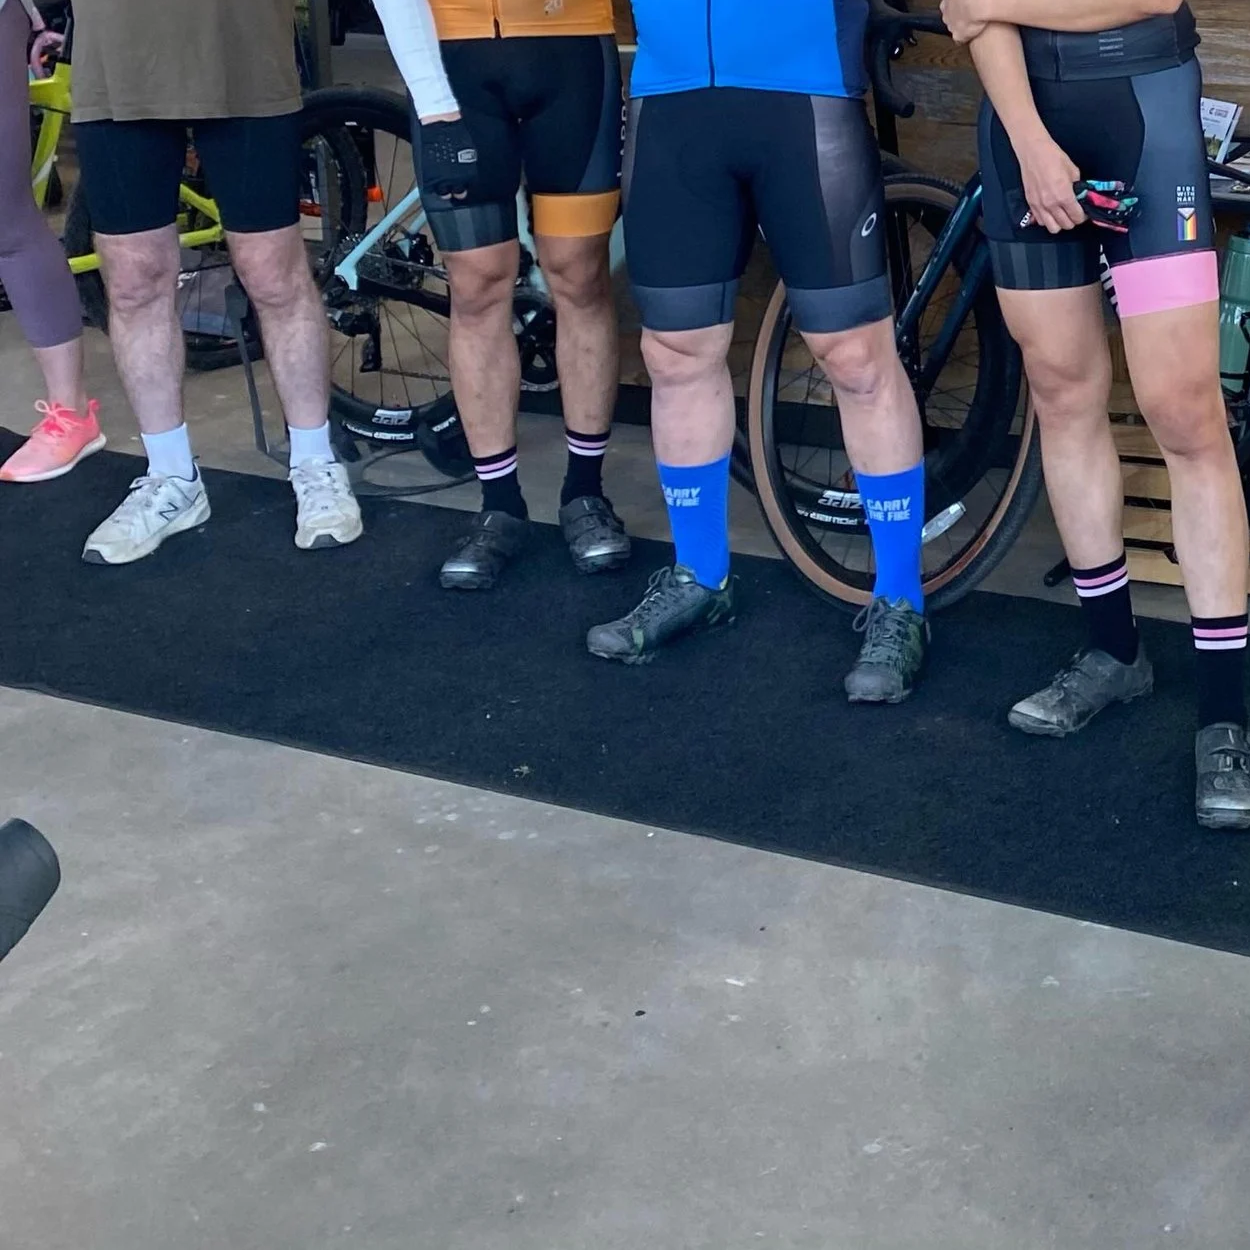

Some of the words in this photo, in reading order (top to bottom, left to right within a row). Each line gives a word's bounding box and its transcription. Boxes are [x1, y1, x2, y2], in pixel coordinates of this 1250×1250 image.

[662, 486, 701, 499] ARRY
[866, 497, 911, 512] CARRY
[868, 510, 885, 522] THE
[887, 509, 911, 522] FIRE
